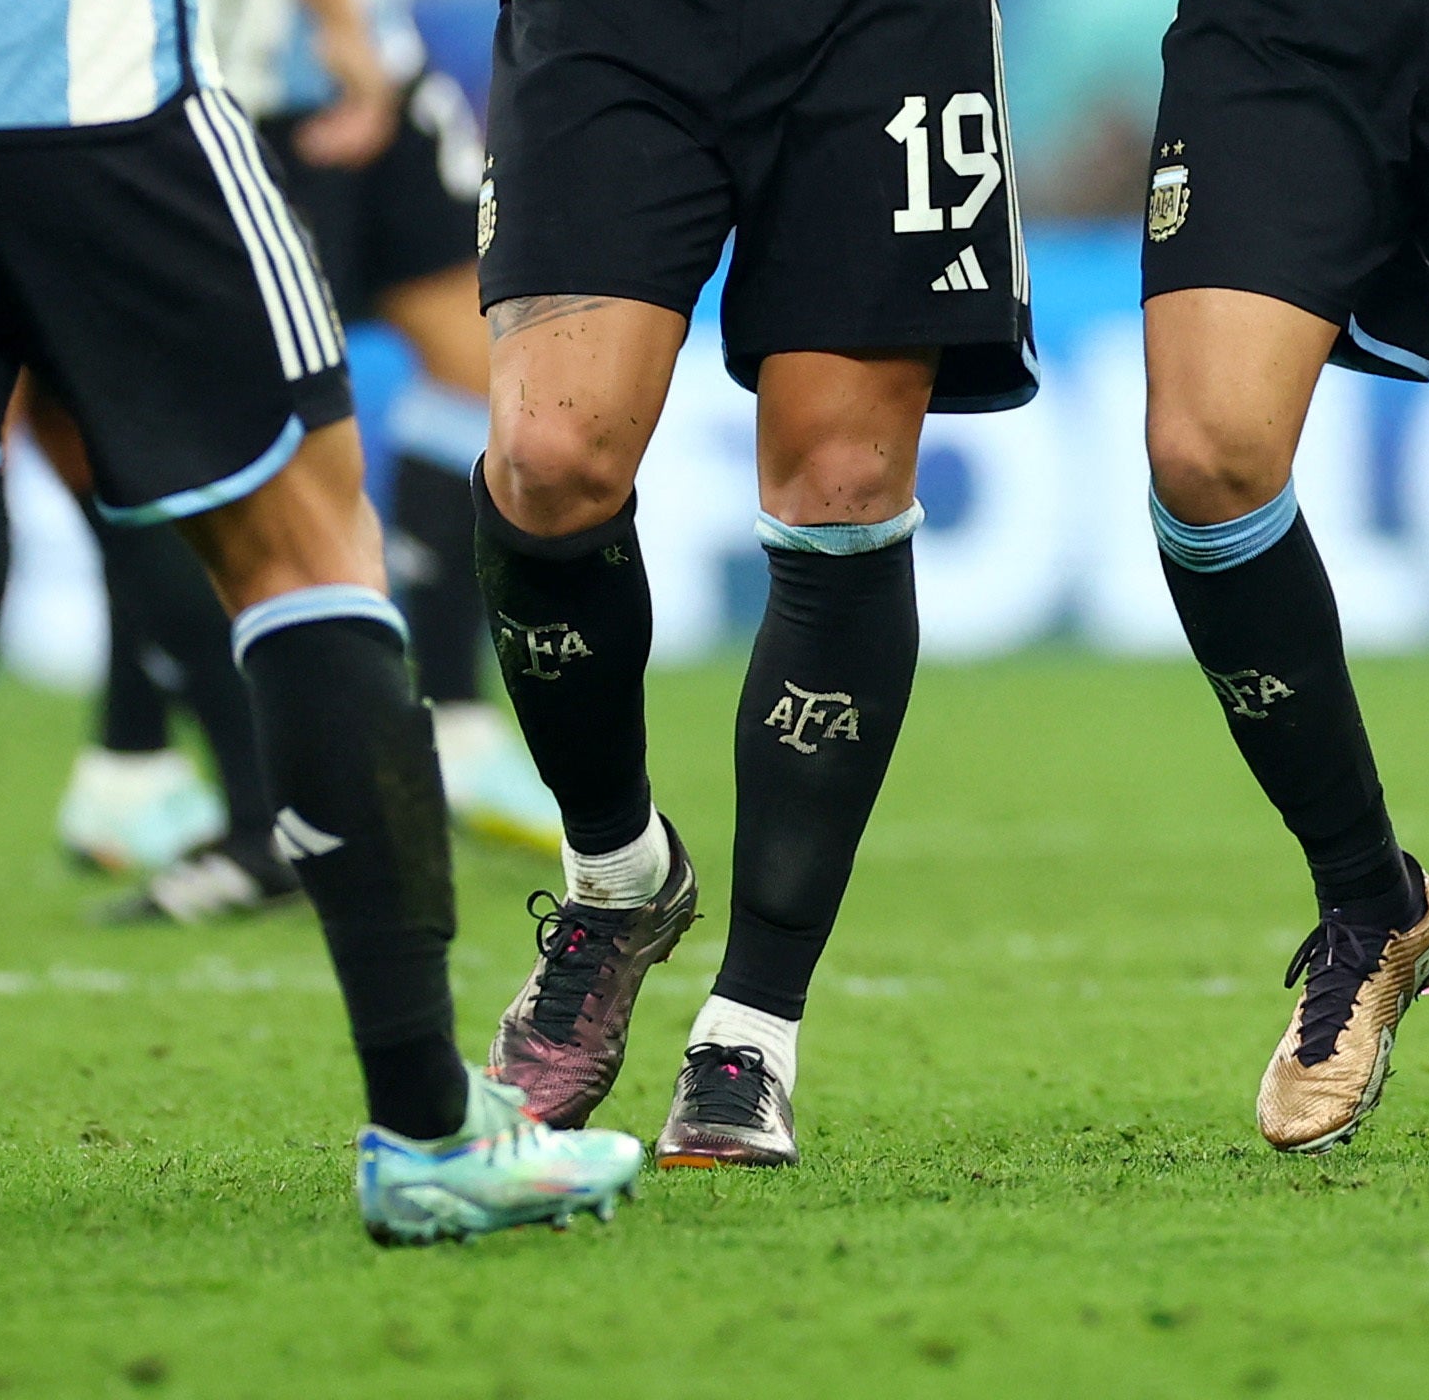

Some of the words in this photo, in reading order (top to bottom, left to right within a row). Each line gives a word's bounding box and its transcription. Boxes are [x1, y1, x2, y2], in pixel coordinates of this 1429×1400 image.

[884, 93, 1002, 233] 19
[497, 610, 594, 680] FA
[764, 680, 860, 754] AFA
